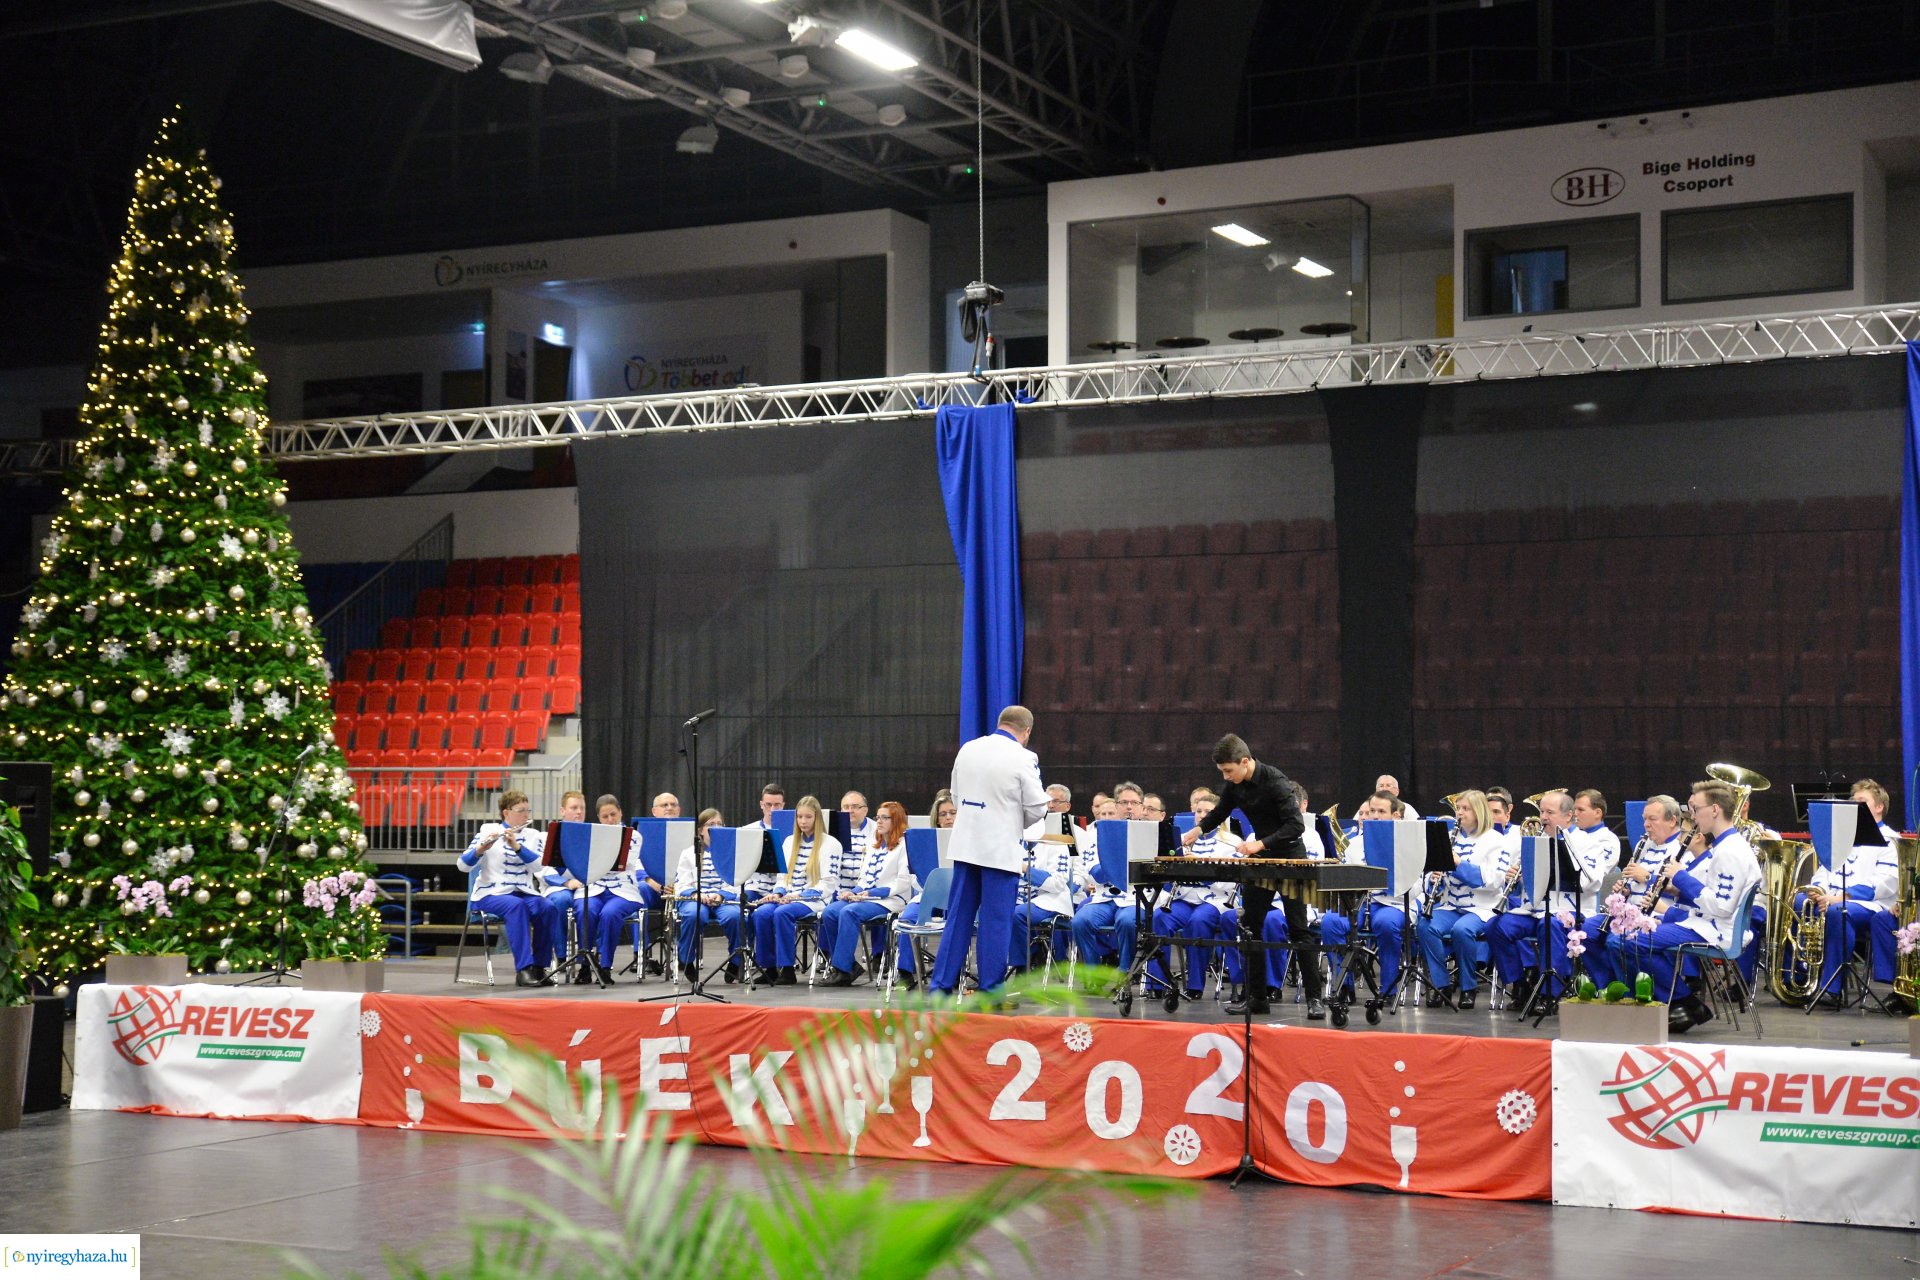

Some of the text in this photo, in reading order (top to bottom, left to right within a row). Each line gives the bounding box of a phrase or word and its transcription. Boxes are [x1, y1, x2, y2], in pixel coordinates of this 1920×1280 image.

[1642, 153, 1756, 176] Bige Holding
[1566, 173, 1612, 201] BH
[1663, 174, 1734, 193] Csoport
[466, 258, 548, 275] NYÍREGYHÁZA
[661, 368, 719, 390] Többet
[200, 1045, 301, 1060] www.reveszgroup.com
[986, 1032, 1347, 1164] 2020
[1727, 1071, 1920, 1119] REVES
